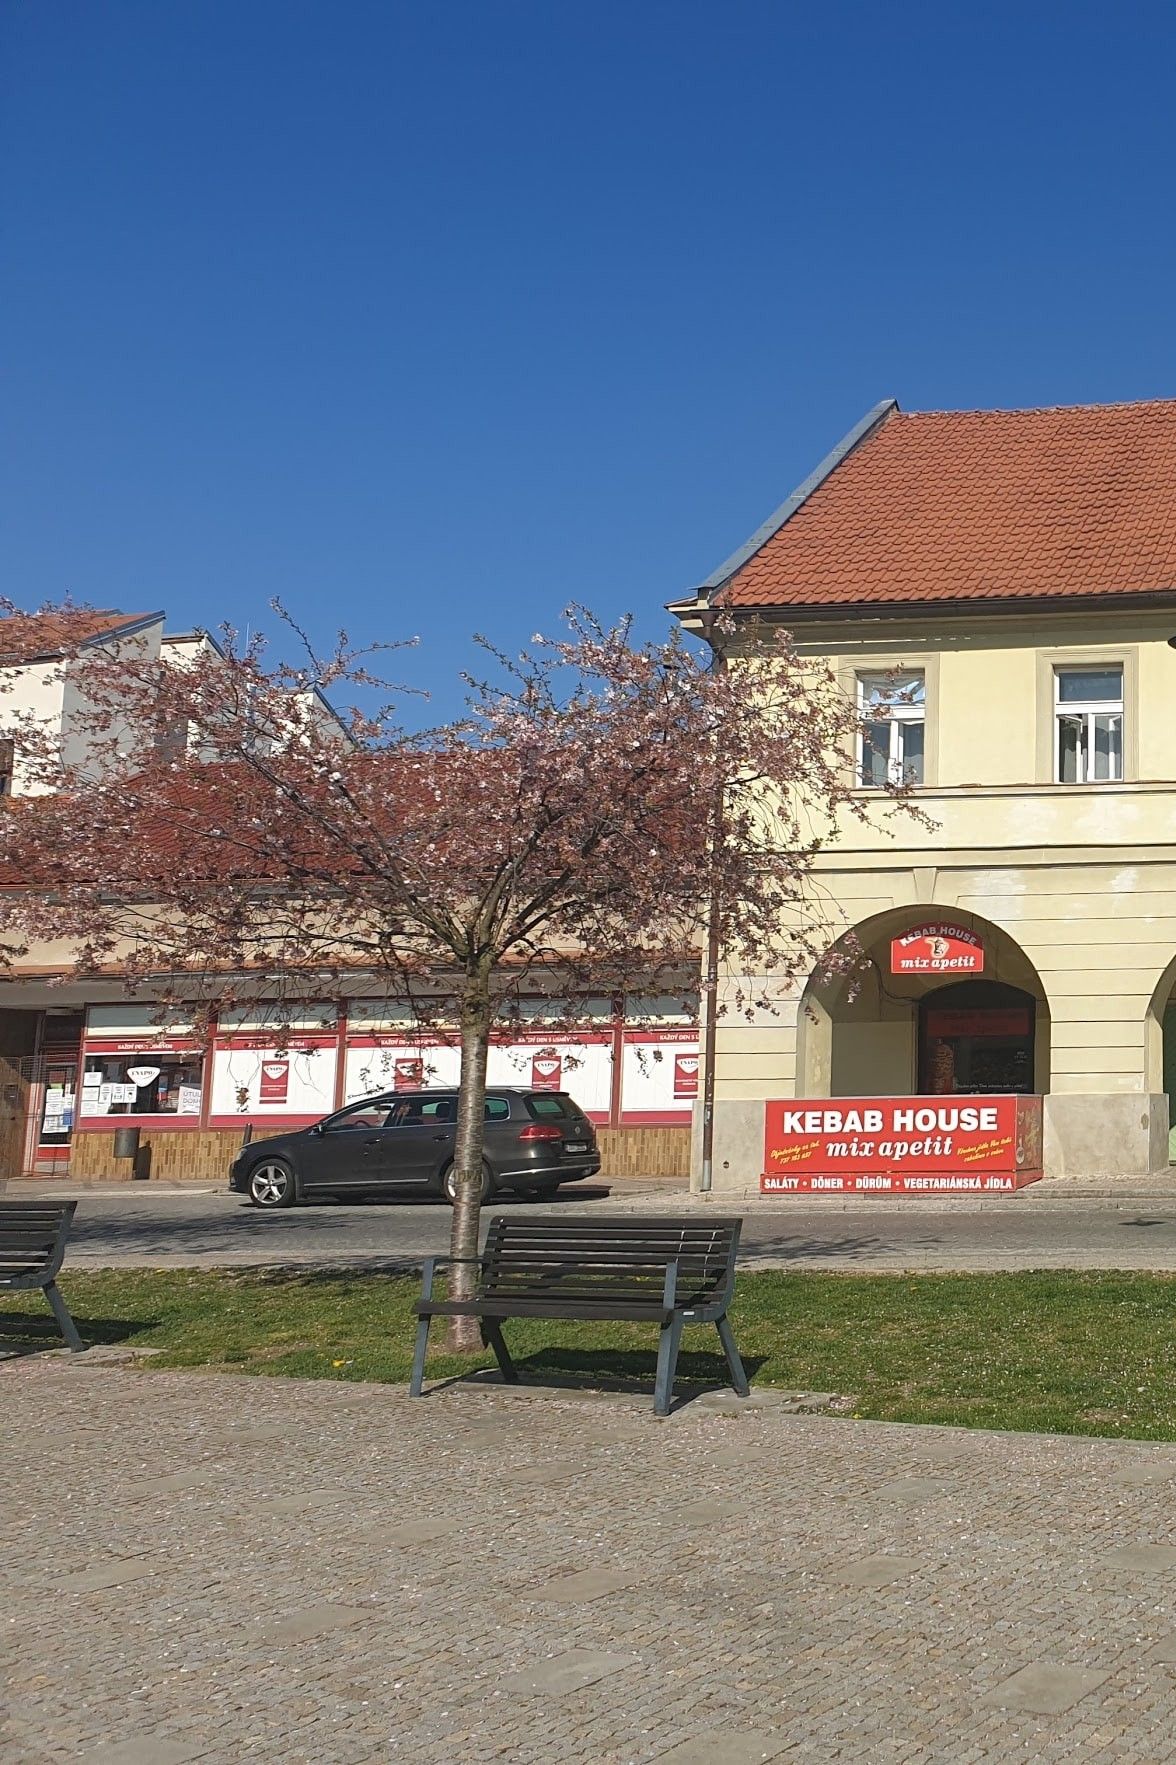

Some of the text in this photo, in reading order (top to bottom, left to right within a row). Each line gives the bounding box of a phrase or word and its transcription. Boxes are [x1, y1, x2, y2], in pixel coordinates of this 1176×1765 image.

[899, 926, 978, 947] KEBAB HOUSE
[901, 955, 976, 970] mix apetit
[783, 1107, 998, 1134] KEBAB HOUSE
[826, 1136, 953, 1161] mix apetit
[764, 1176, 799, 1189] SALÁTY
[811, 1176, 844, 1189] DÖNER
[903, 1175, 981, 1189] VEGETARIÁNSKÁ
[983, 1175, 1013, 1189] JÍDLA
